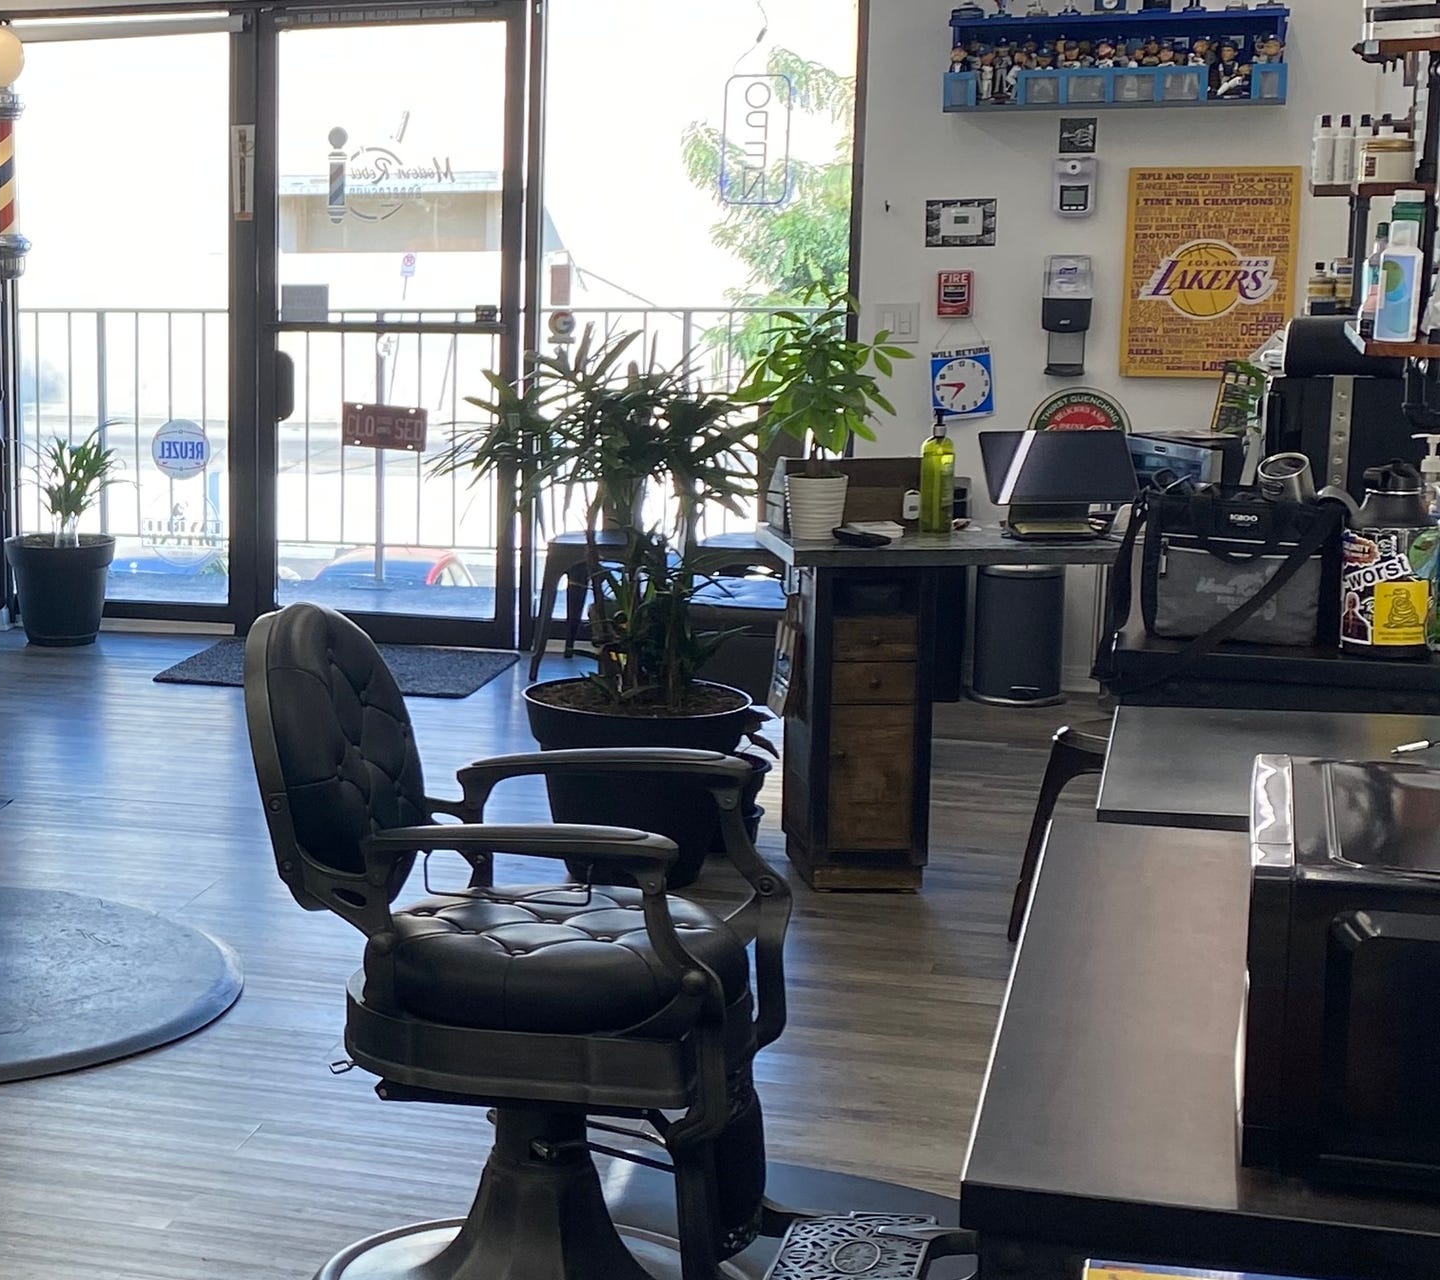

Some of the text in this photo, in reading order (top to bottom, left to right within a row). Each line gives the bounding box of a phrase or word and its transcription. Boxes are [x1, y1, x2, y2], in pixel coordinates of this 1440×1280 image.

[1143, 198, 1274, 206] TIME NBA CHAMPIONS
[1212, 259, 1269, 267] ANGELES
[941, 273, 969, 283] FIRE
[1146, 260, 1270, 300] LAKERS
[931, 346, 990, 359] WILL RETURN
[1041, 395, 1120, 423] THIRST QUENCHING
[346, 415, 374, 437] CLO
[395, 419, 422, 441] SED
[1229, 513, 1258, 522] IGLOO
[1348, 556, 1409, 591] worst
